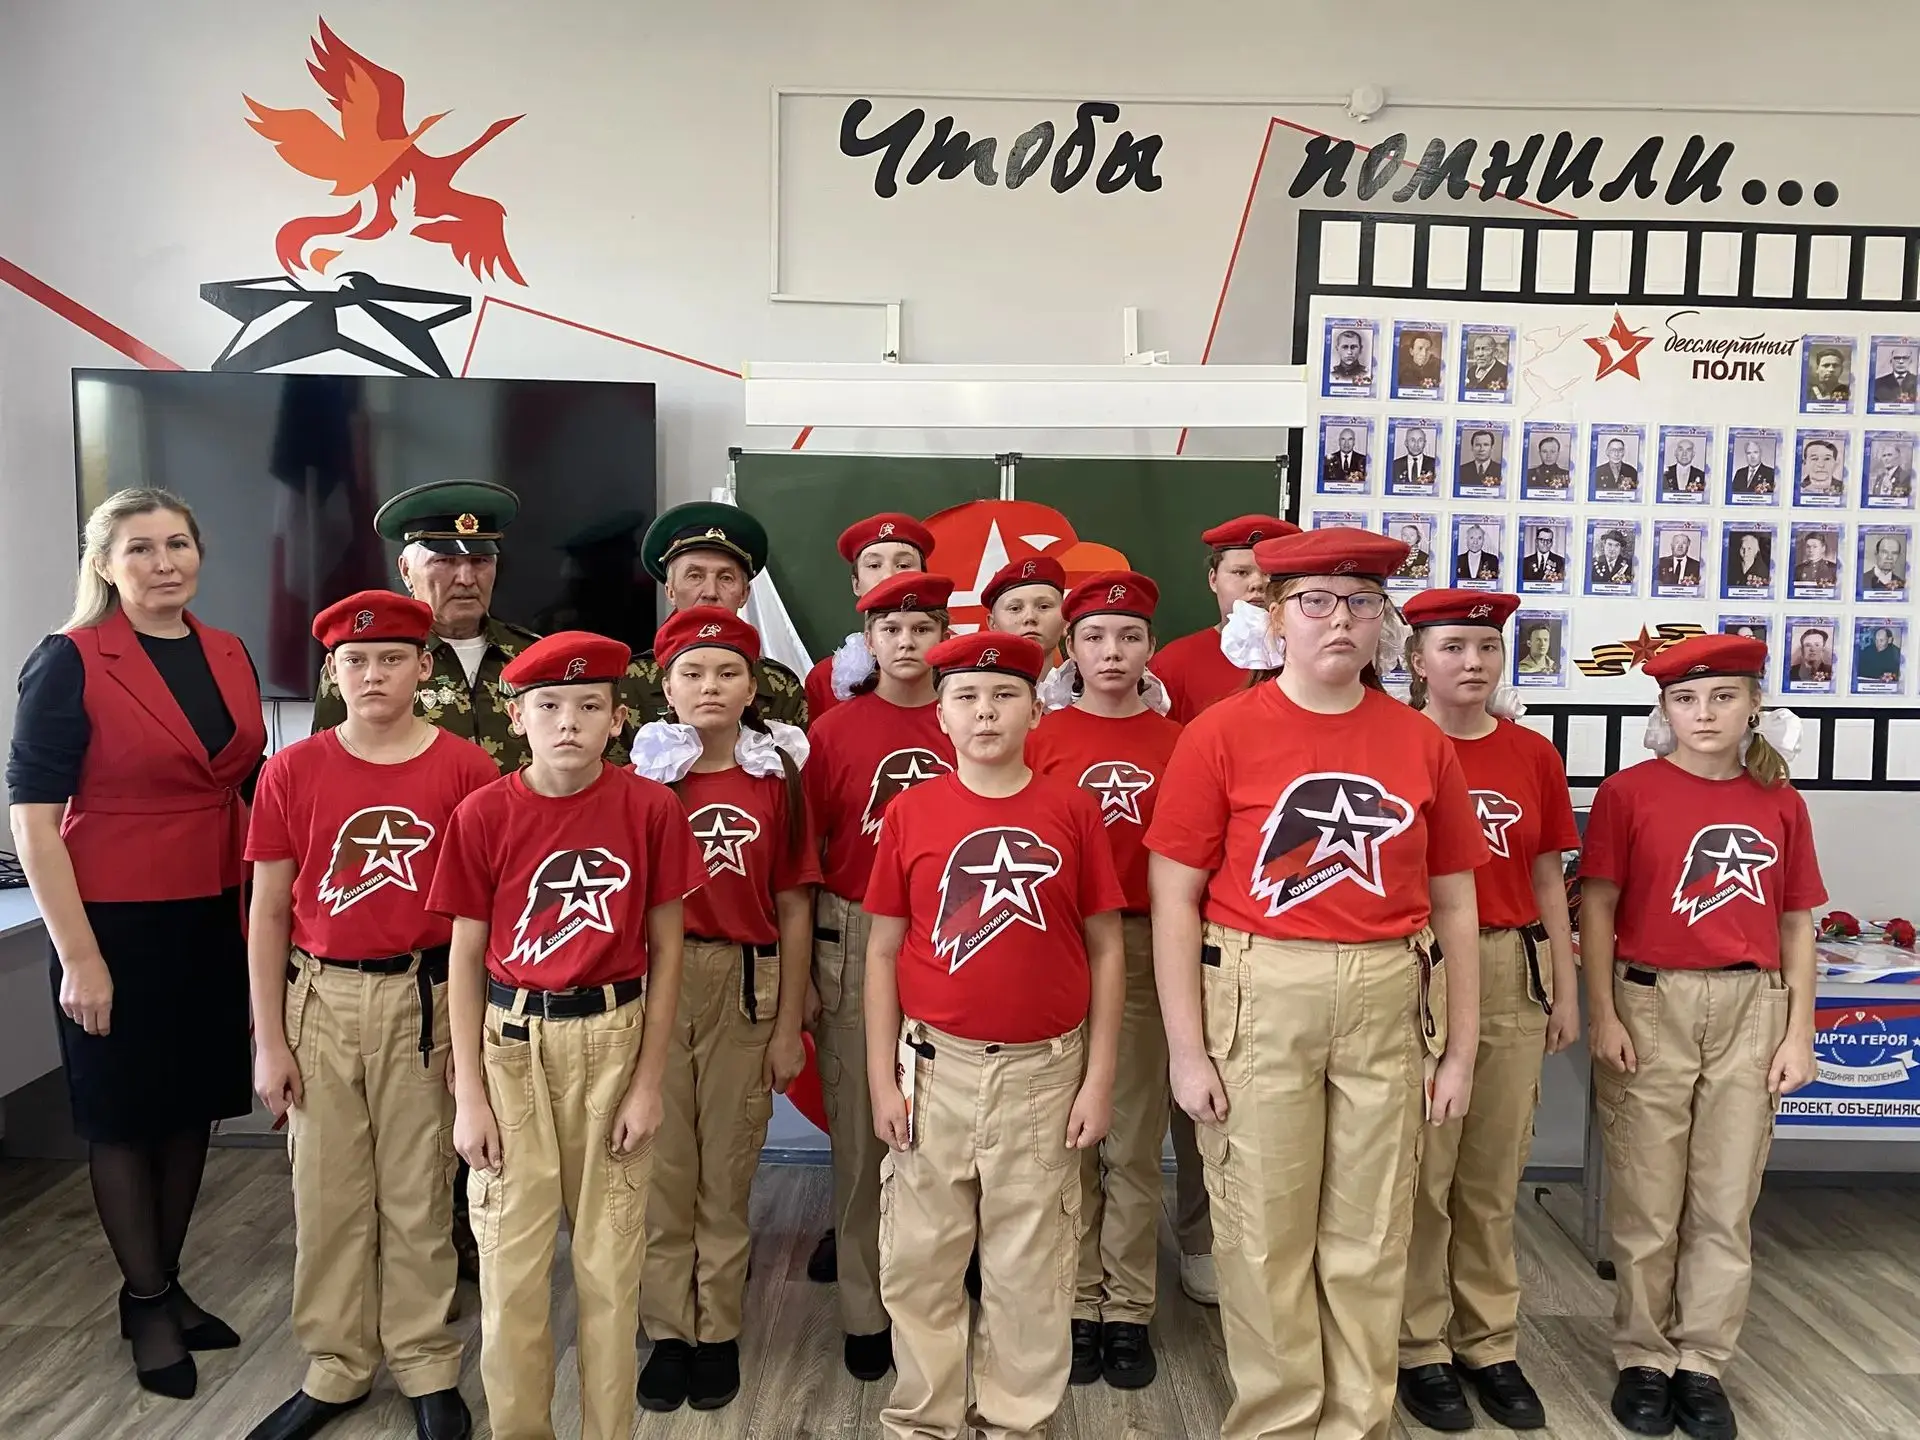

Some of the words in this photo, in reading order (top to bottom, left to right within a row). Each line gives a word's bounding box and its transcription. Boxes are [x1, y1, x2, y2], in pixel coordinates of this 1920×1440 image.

[840, 98, 1163, 198] Чтобы
[1692, 360, 1765, 381] ПОЛК
[343, 872, 384, 901] ЮНАРМИЯ
[1288, 862, 1344, 897] ЮНАРМИЯ
[1698, 883, 1737, 910] ЮНАРМИЯ
[964, 909, 1010, 950] ЮНАРМИЯ
[1861, 1034, 1908, 1046] ГЕРОЯ
[1781, 1101, 1833, 1116] ПРОЕКТ,
